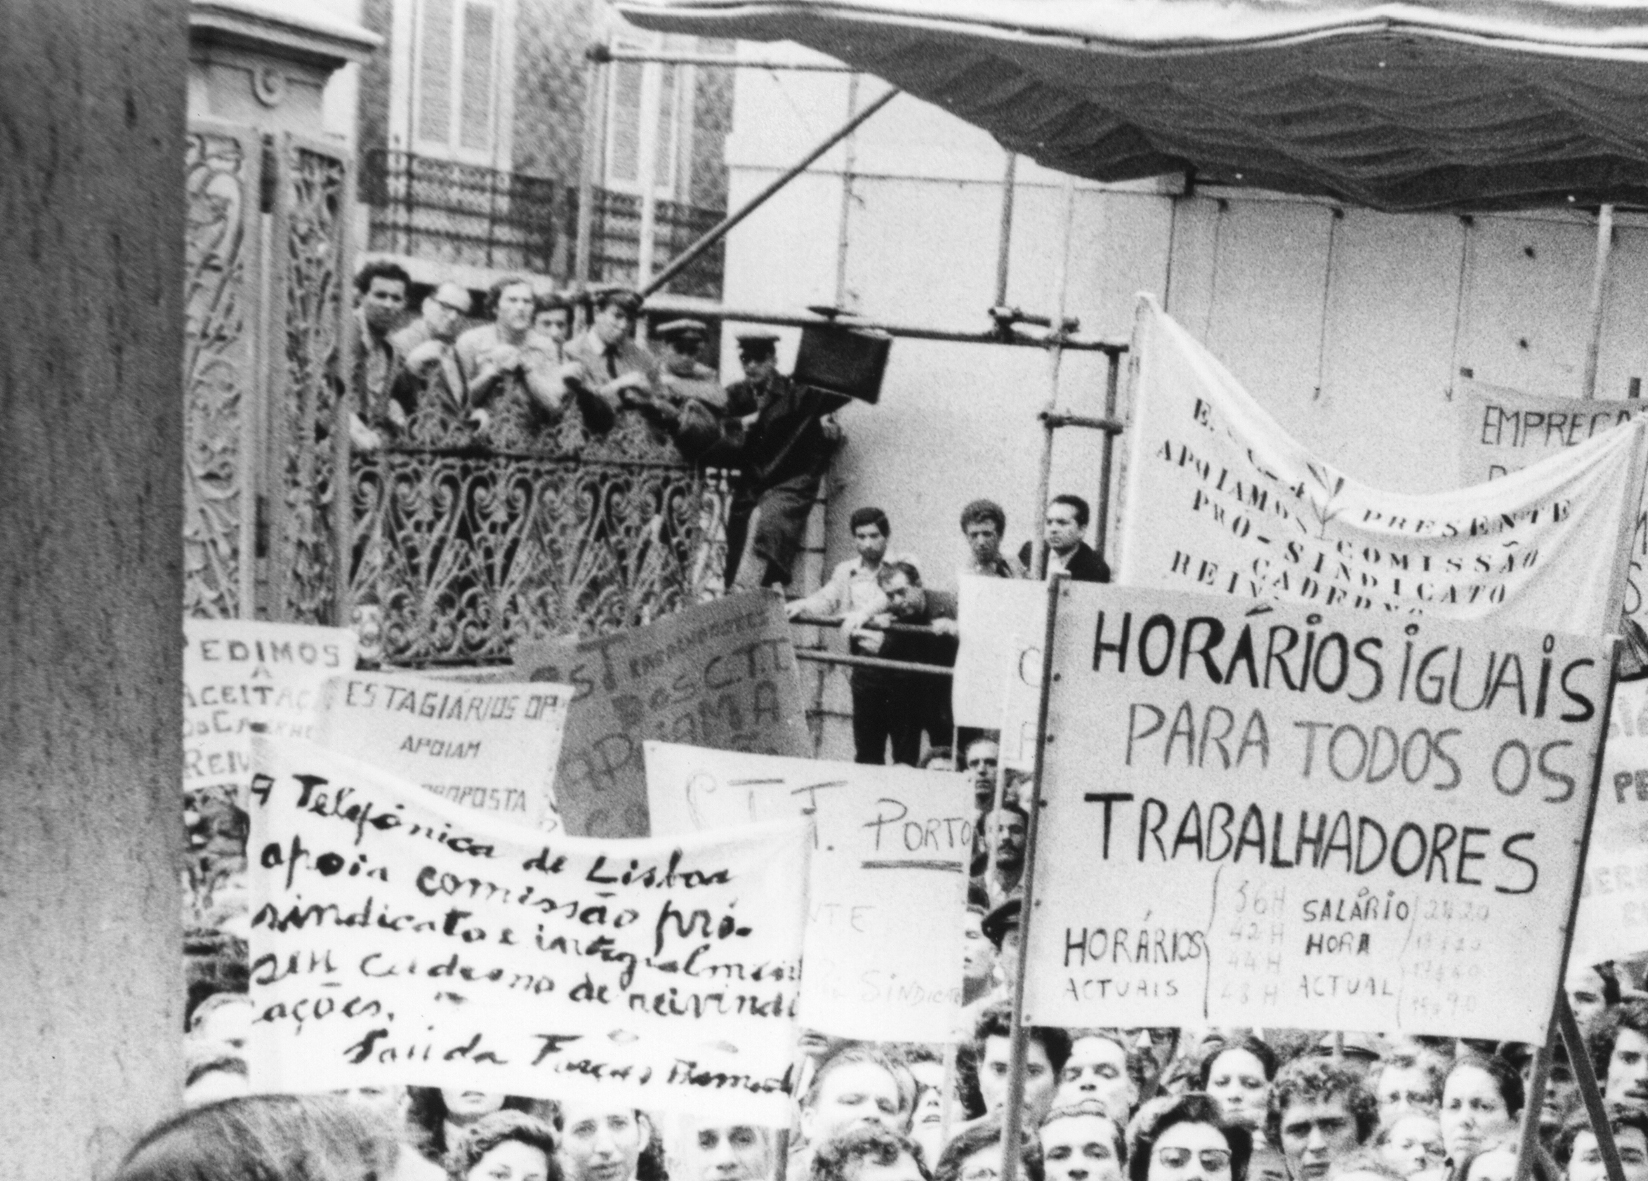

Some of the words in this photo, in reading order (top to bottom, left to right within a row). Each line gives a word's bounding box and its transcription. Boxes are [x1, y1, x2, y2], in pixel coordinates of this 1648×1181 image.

[187, 639, 340, 668] EDIMOS
[400, 735, 481, 759] APOIAM
[1125, 700, 1270, 770] PARA
[1293, 720, 1462, 791] TODOS
[1491, 738, 1576, 804] OS
[862, 798, 972, 851] PORTO
[1084, 793, 1538, 895] TRABALHADORES
[260, 834, 389, 891] apoia
[522, 846, 567, 874] de
[586, 846, 732, 889] Lisboa
[250, 895, 487, 943] sindicato
[1064, 909, 1205, 968] HORÁRIOS
[1305, 932, 1370, 955] HORA
[568, 972, 610, 1004] de
[1066, 977, 1179, 1001] ACTUAIS
[1300, 974, 1393, 998] ACTUAL
